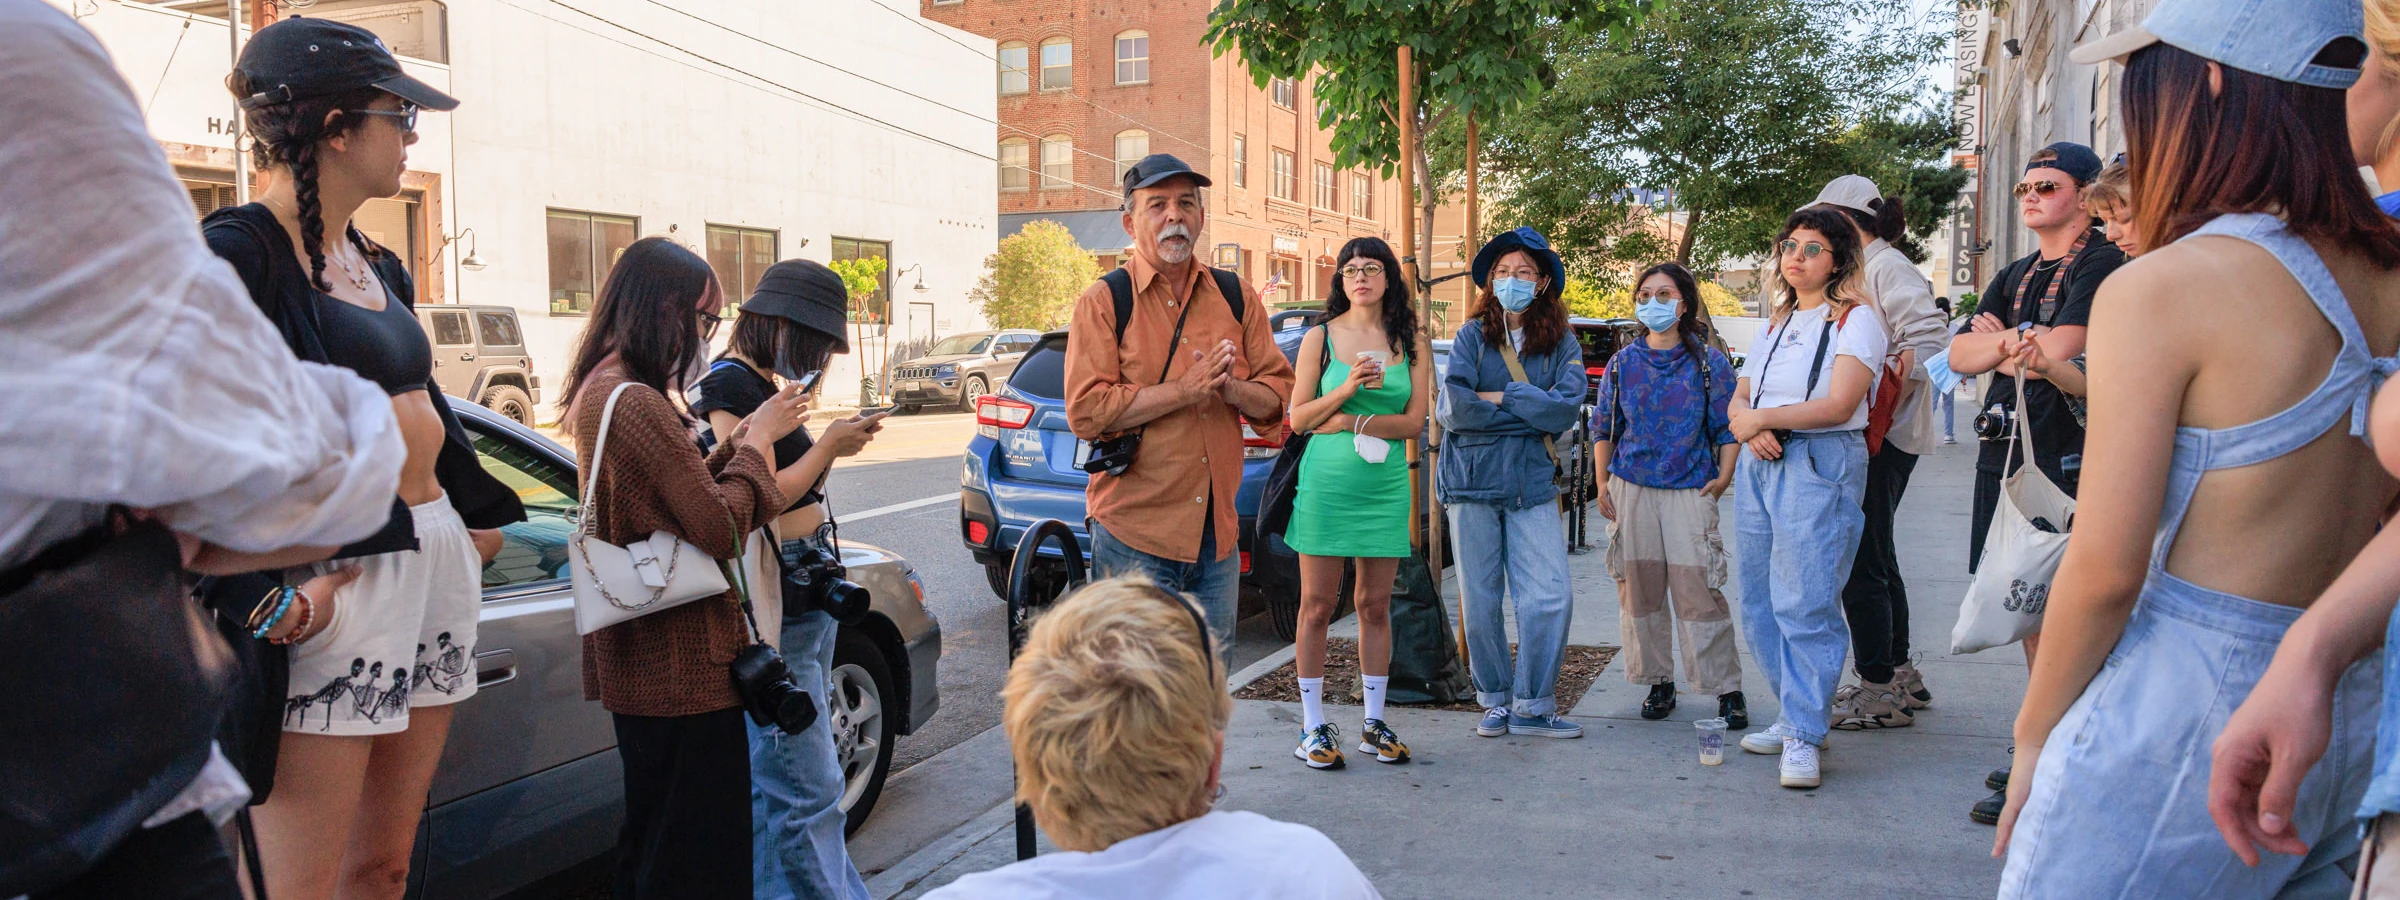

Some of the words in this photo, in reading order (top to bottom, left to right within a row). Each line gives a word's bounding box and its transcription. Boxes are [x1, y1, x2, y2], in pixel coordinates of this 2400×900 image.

[1960, 15, 1978, 96] LEASING
[1957, 104, 1975, 151] NOW
[1956, 193, 1974, 283] ALISO
